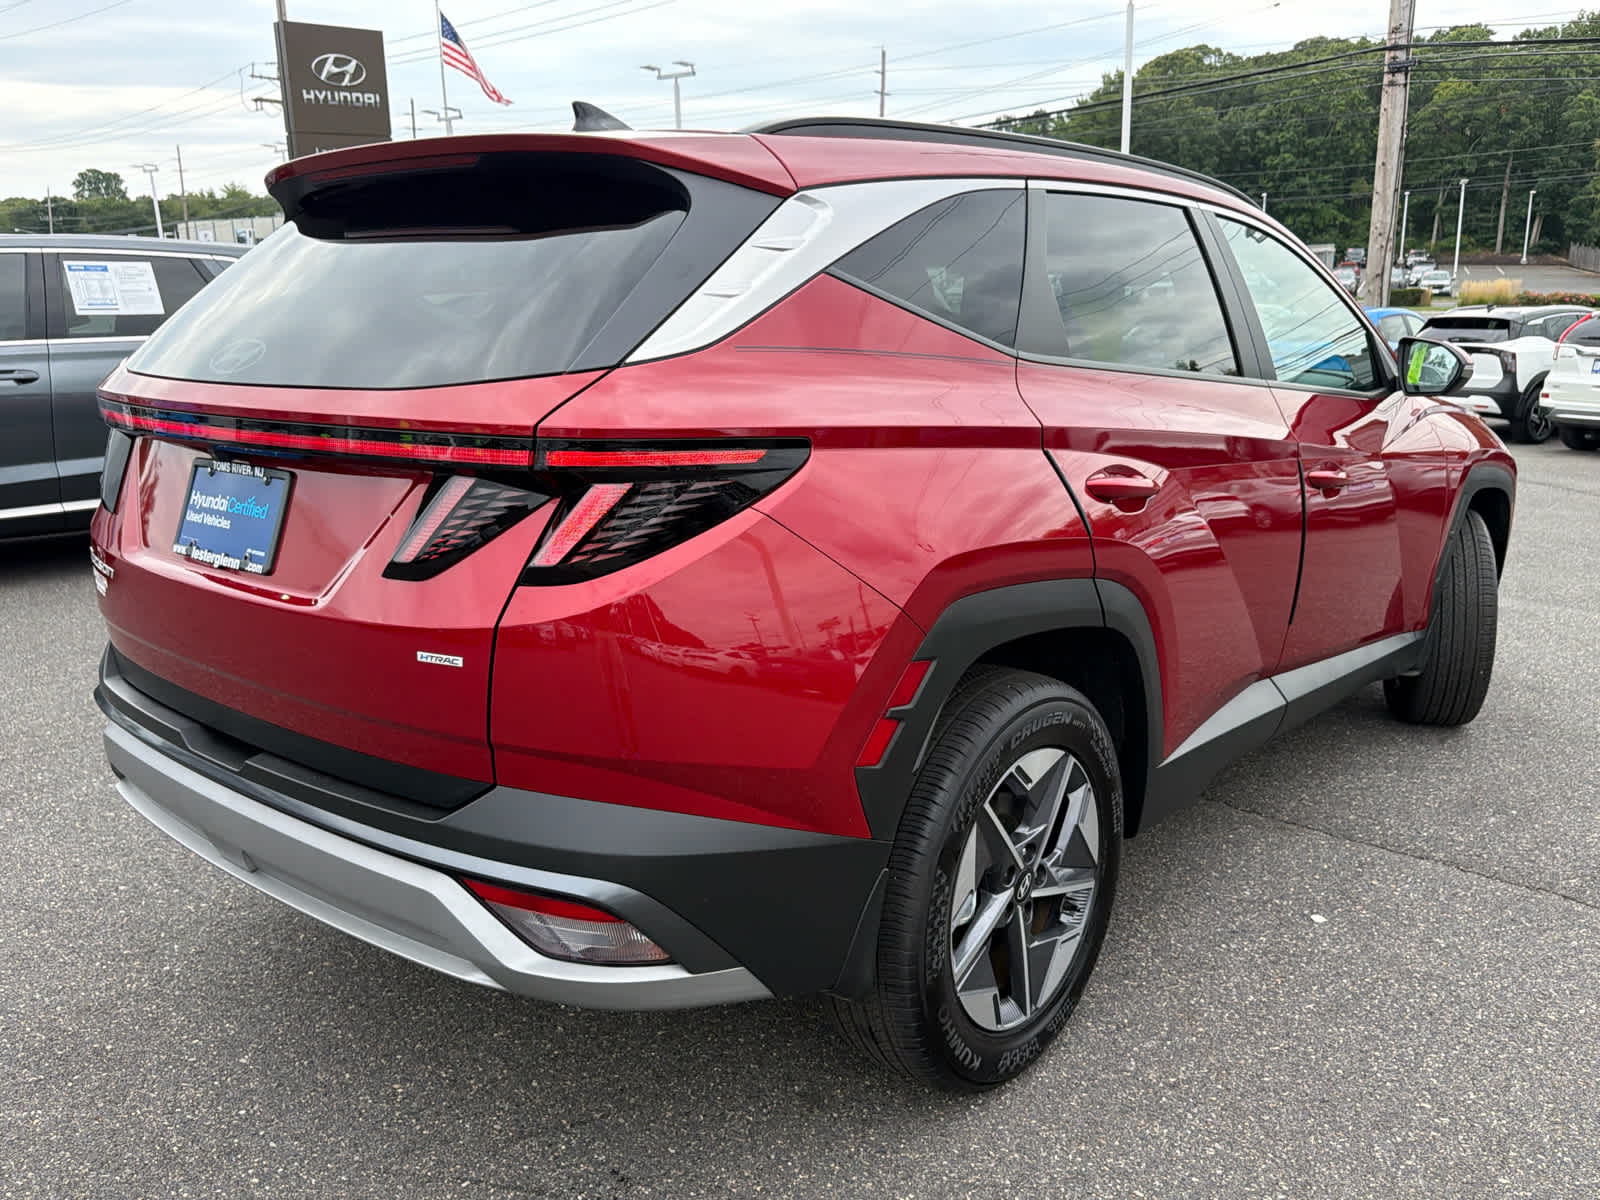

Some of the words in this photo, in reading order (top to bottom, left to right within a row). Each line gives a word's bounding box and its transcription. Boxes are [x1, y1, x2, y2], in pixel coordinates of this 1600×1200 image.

[302, 88, 380, 109] HYUNDAI
[213, 460, 231, 473] TOMS
[254, 466, 265, 478] NJ
[185, 510, 204, 524] Used
[203, 513, 231, 529] Vehicles
[191, 546, 240, 570] lesterglenn
[419, 653, 461, 666] HTRAC
[1010, 711, 1073, 750] CRUGEN
[937, 1004, 983, 1072] KUMHO
